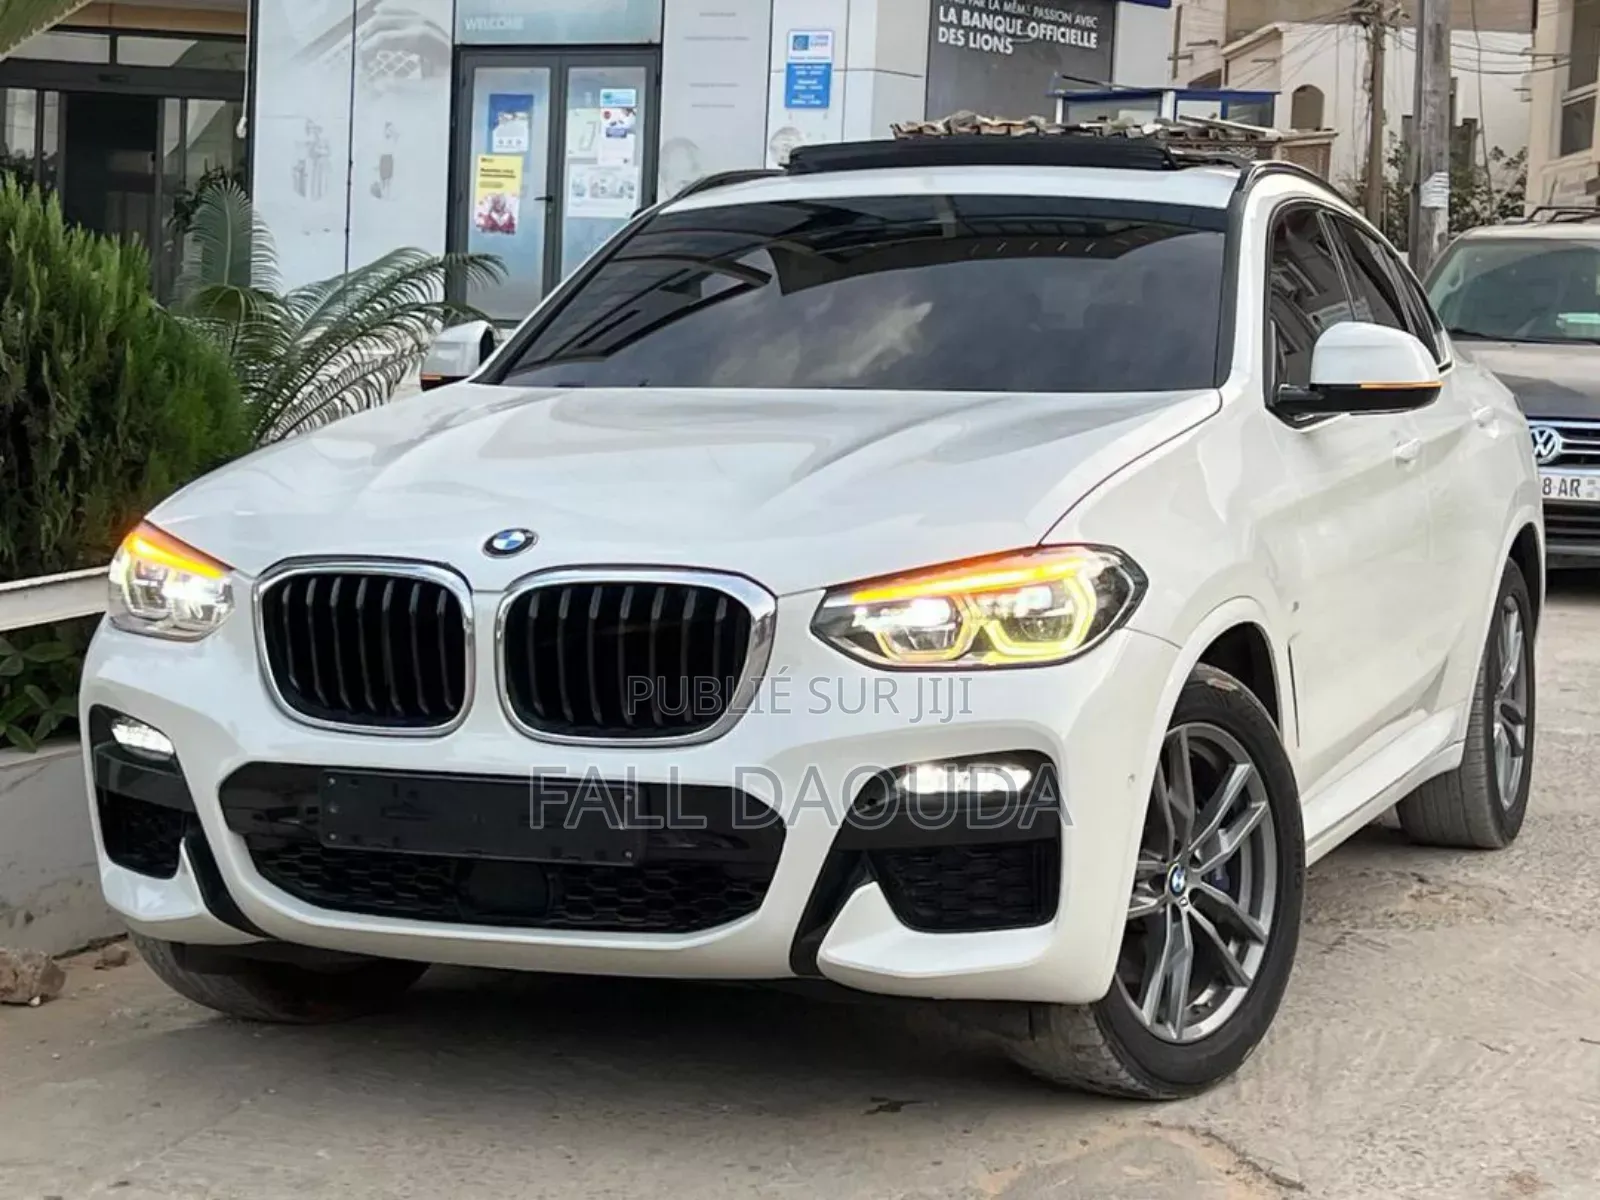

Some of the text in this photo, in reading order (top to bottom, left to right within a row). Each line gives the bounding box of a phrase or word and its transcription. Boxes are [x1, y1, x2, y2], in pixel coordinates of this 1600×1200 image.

[939, 5, 1098, 49] LA BANQUE OFFICIELLE
[1033, 6, 1072, 24] PASSION
[1074, 14, 1098, 28] AVEC
[938, 26, 1013, 55] DES LIONS
[1557, 478, 1581, 498] AR
